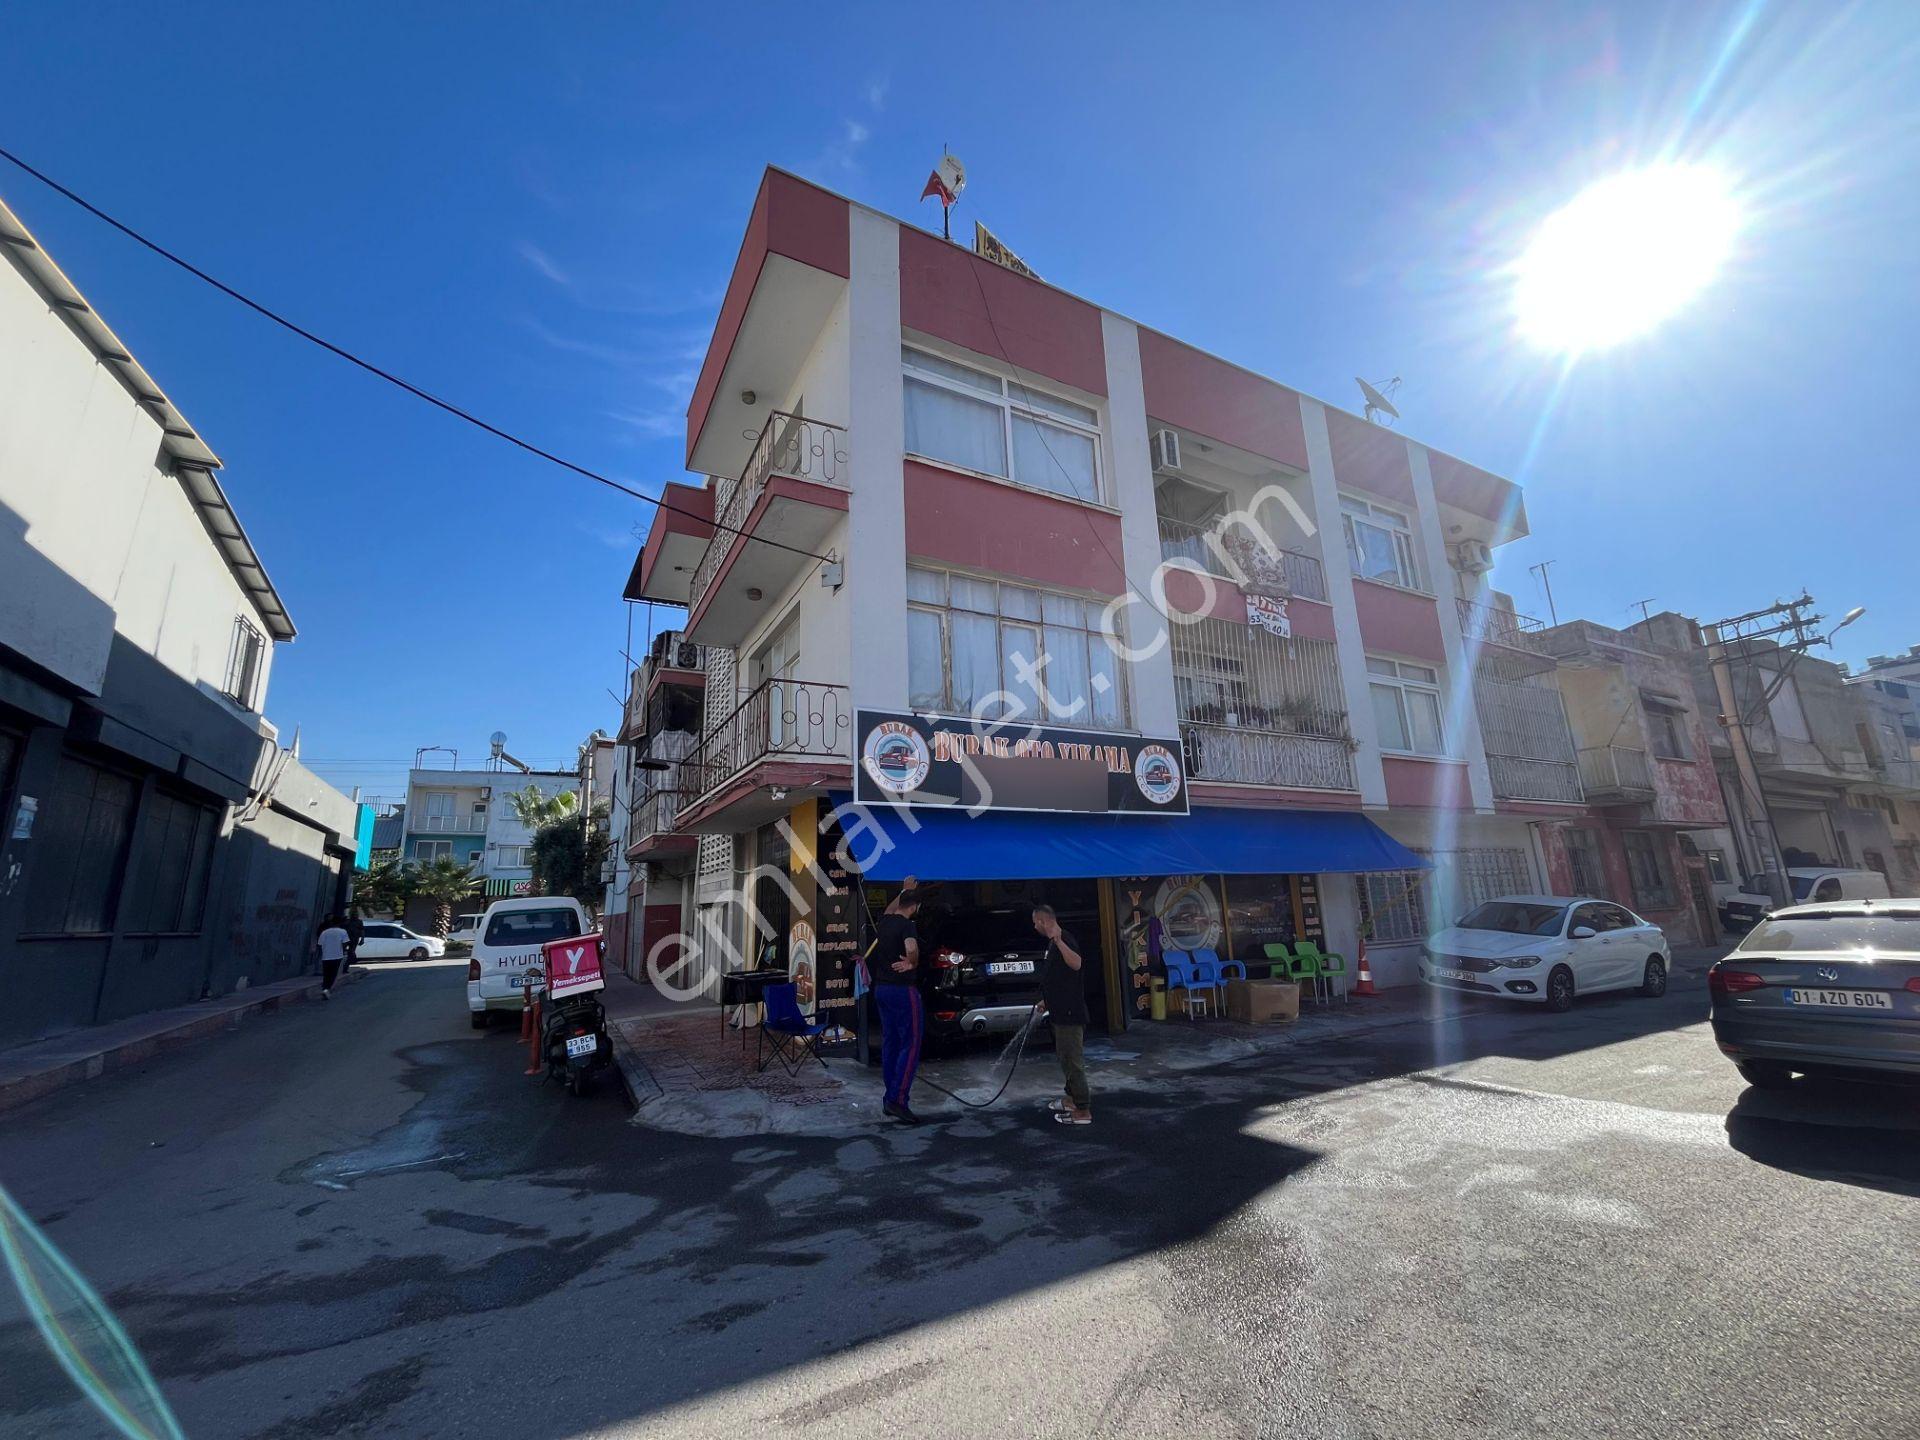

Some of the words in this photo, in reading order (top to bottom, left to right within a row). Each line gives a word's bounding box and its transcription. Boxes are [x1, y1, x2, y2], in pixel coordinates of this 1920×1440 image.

[879, 722, 914, 738] BURAK
[934, 731, 1009, 763] BURAK
[870, 768, 890, 787] CAR
[895, 770, 926, 790] WASH
[552, 970, 601, 988] Yemeksepeti
[1792, 990, 1810, 1003] 01
[1853, 993, 1885, 1007] 604
